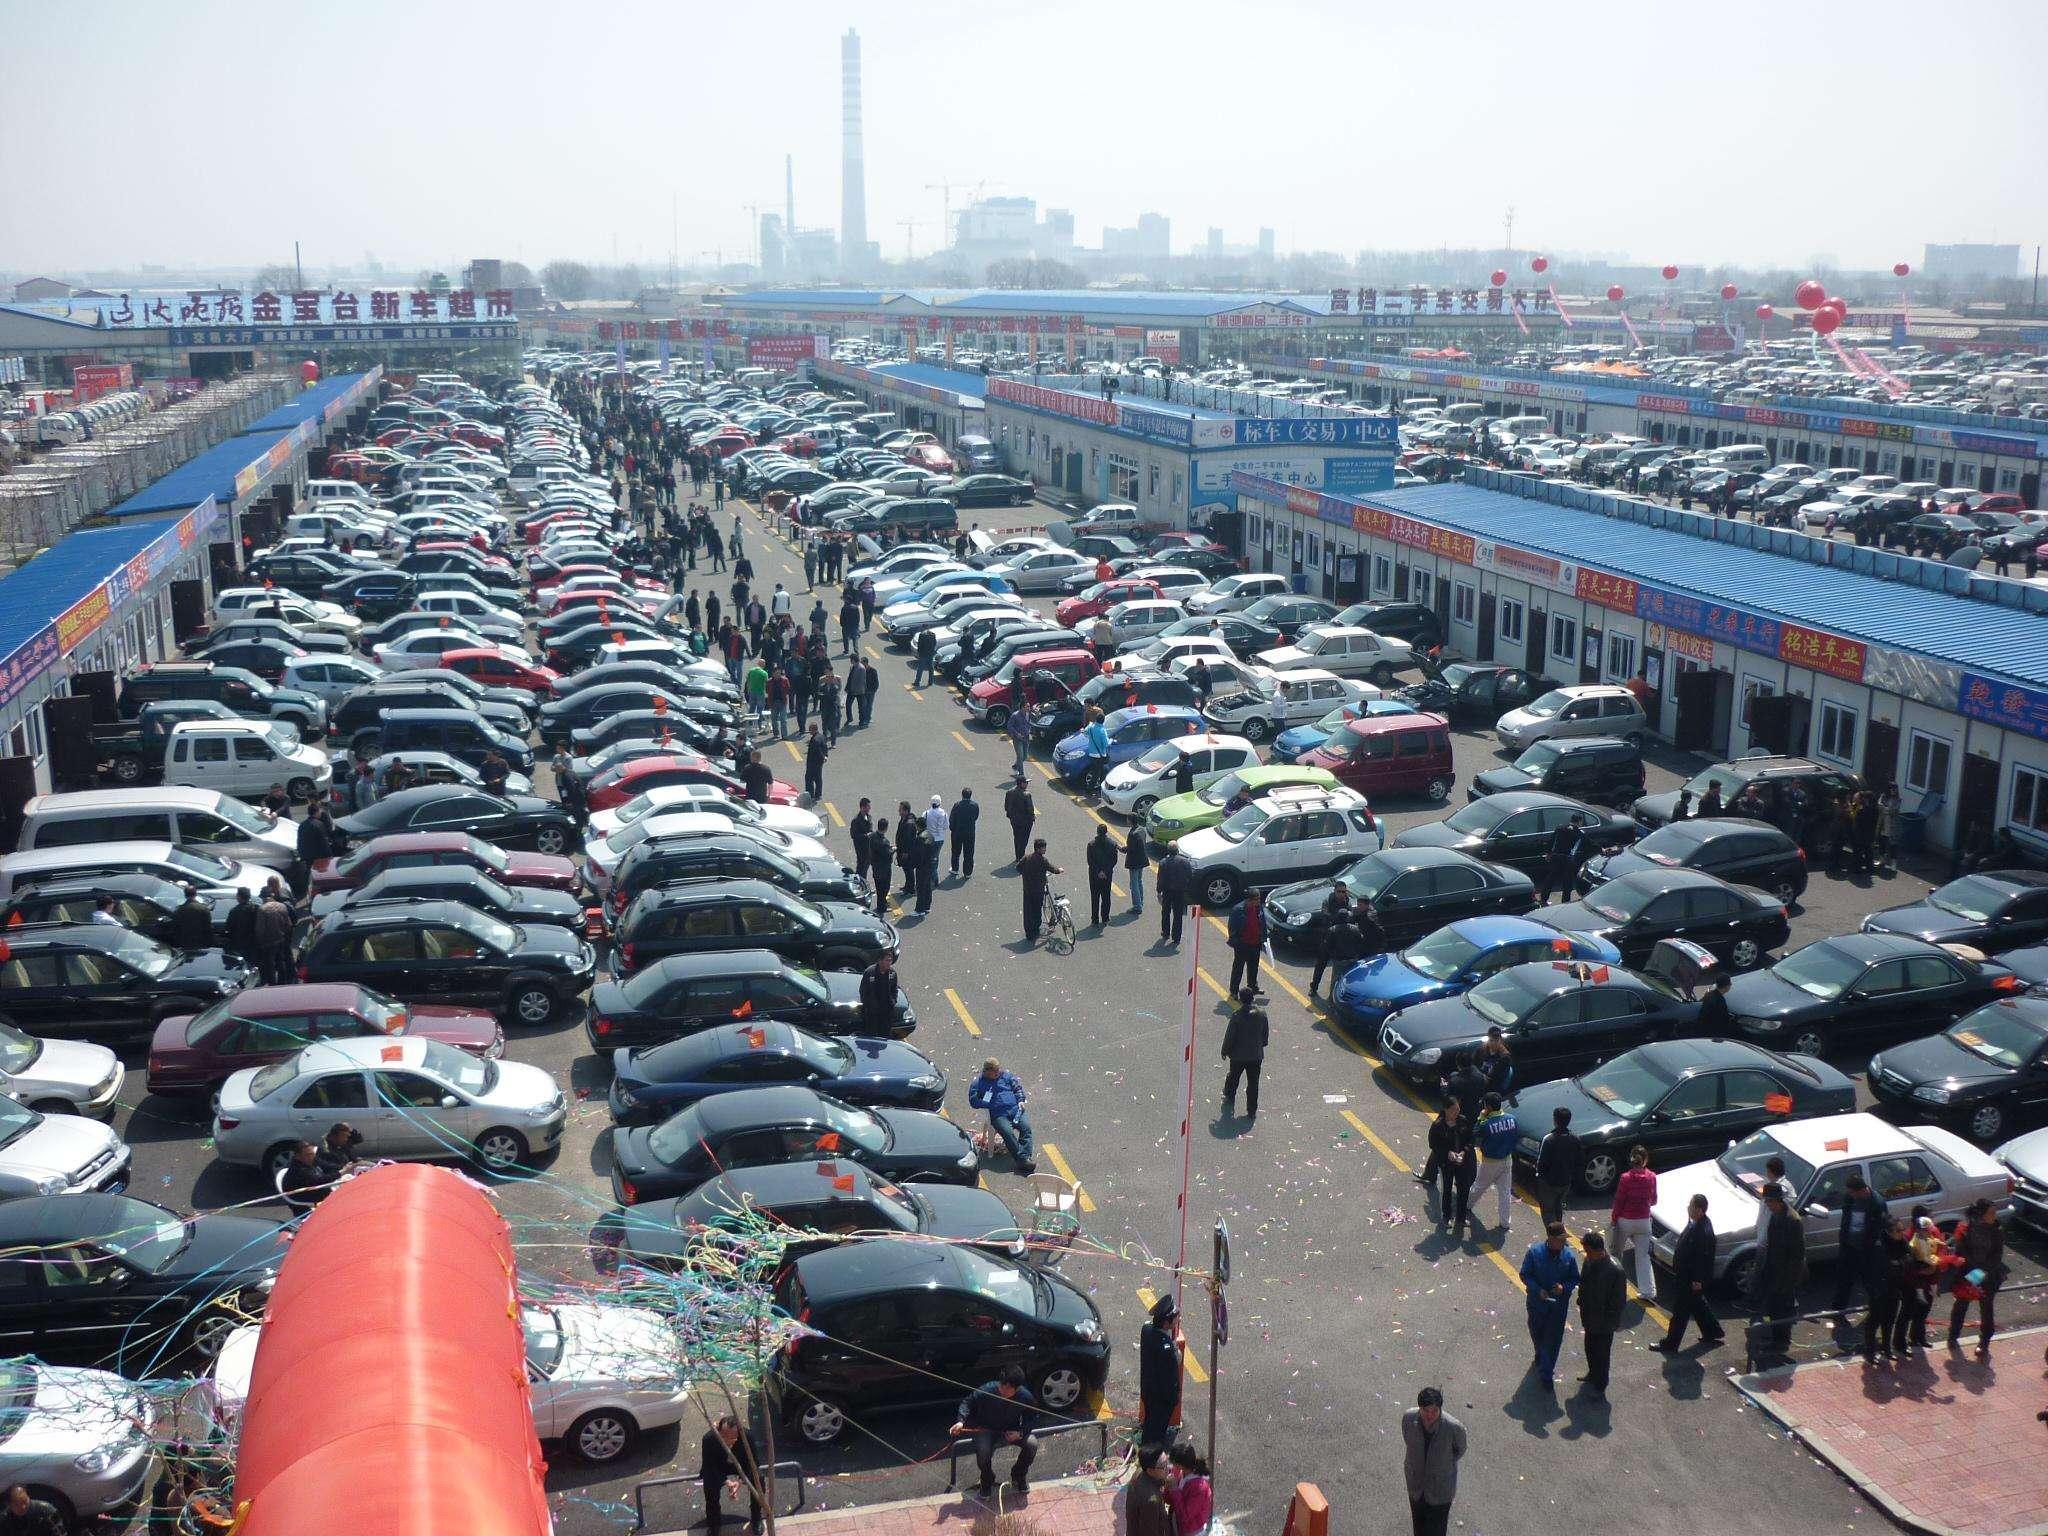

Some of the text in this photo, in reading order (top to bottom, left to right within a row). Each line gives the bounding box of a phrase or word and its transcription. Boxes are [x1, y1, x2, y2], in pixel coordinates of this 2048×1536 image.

[1331, 288, 1551, 312] 高档二手车交易大厅
[1204, 472, 1318, 488] 二手车中心
[1667, 629, 1713, 662] 高价收车
[1784, 629, 1861, 665] 铭浩车业
[1489, 1118, 1516, 1134] ITALIA
